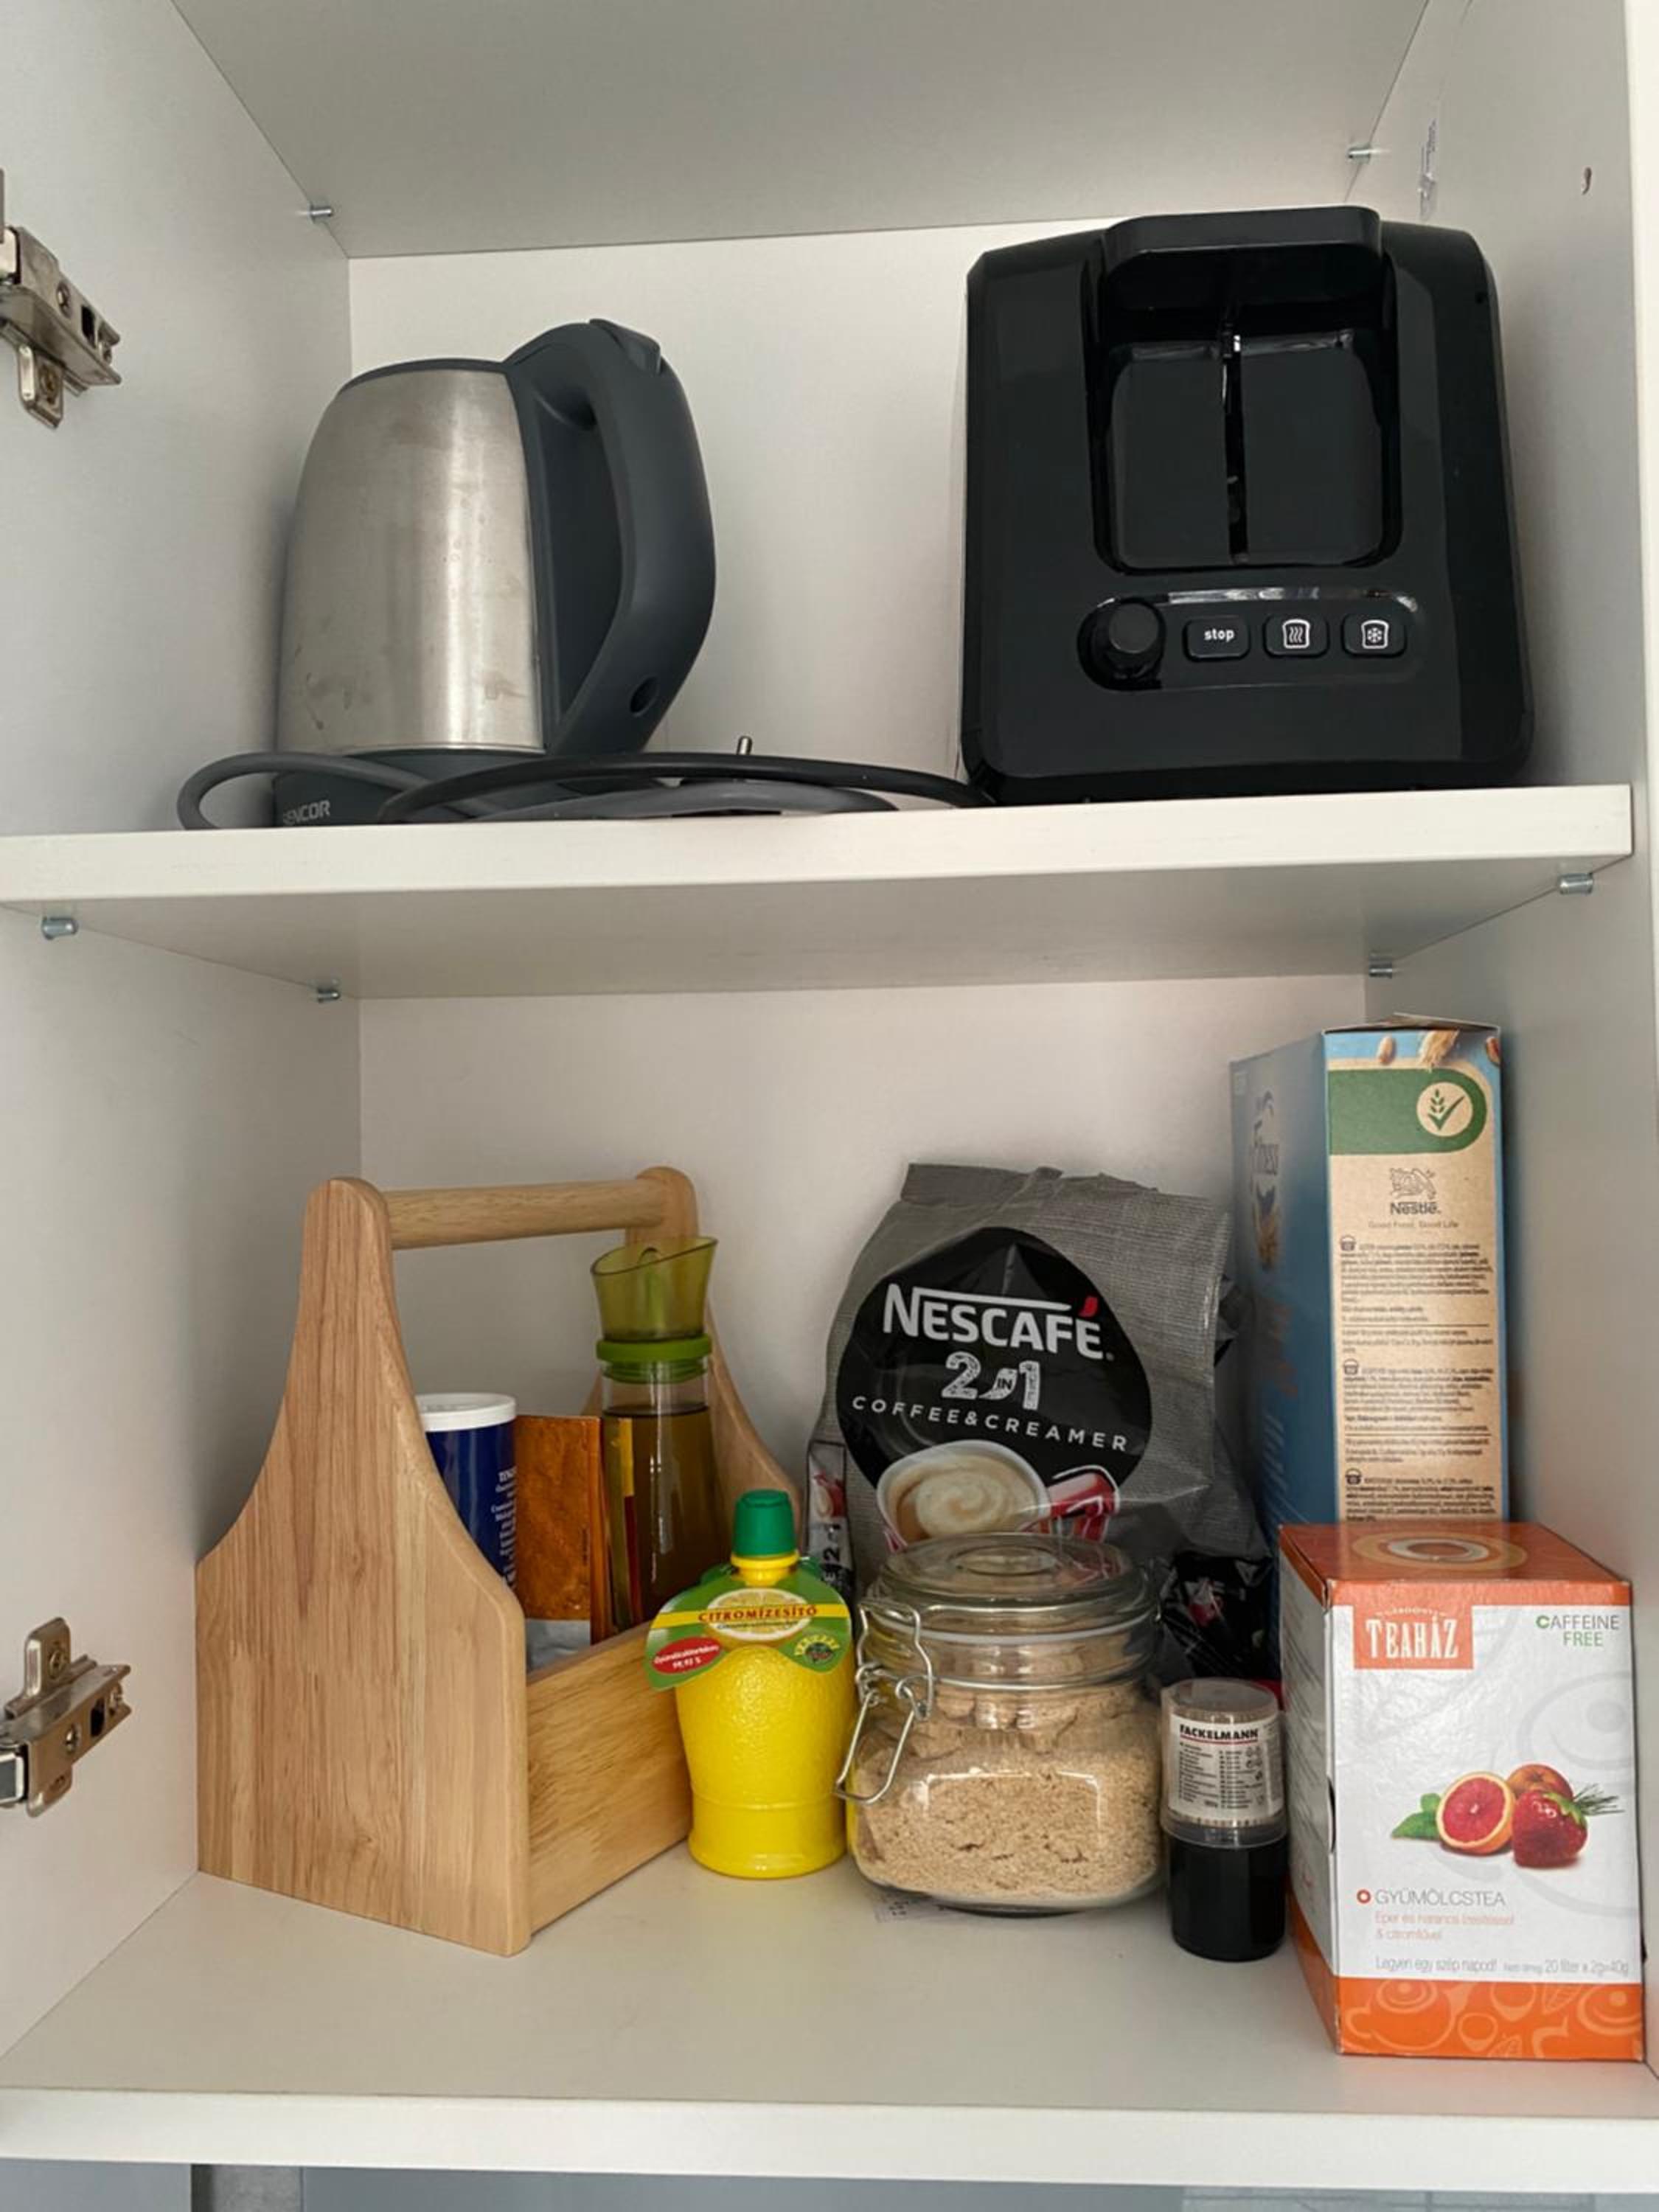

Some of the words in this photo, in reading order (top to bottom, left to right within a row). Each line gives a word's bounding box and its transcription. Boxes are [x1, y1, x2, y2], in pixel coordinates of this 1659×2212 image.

[1204, 628, 1235, 641] stop
[883, 1283, 1105, 1360] NESCAFÉ
[1535, 1614, 1620, 1630] CAFFEINE
[1366, 1613, 1458, 1659] TEAHÁZ
[1563, 1631, 1604, 1646] FREE
[1375, 1887, 1506, 1907] GYÜMÖLCSTEA
